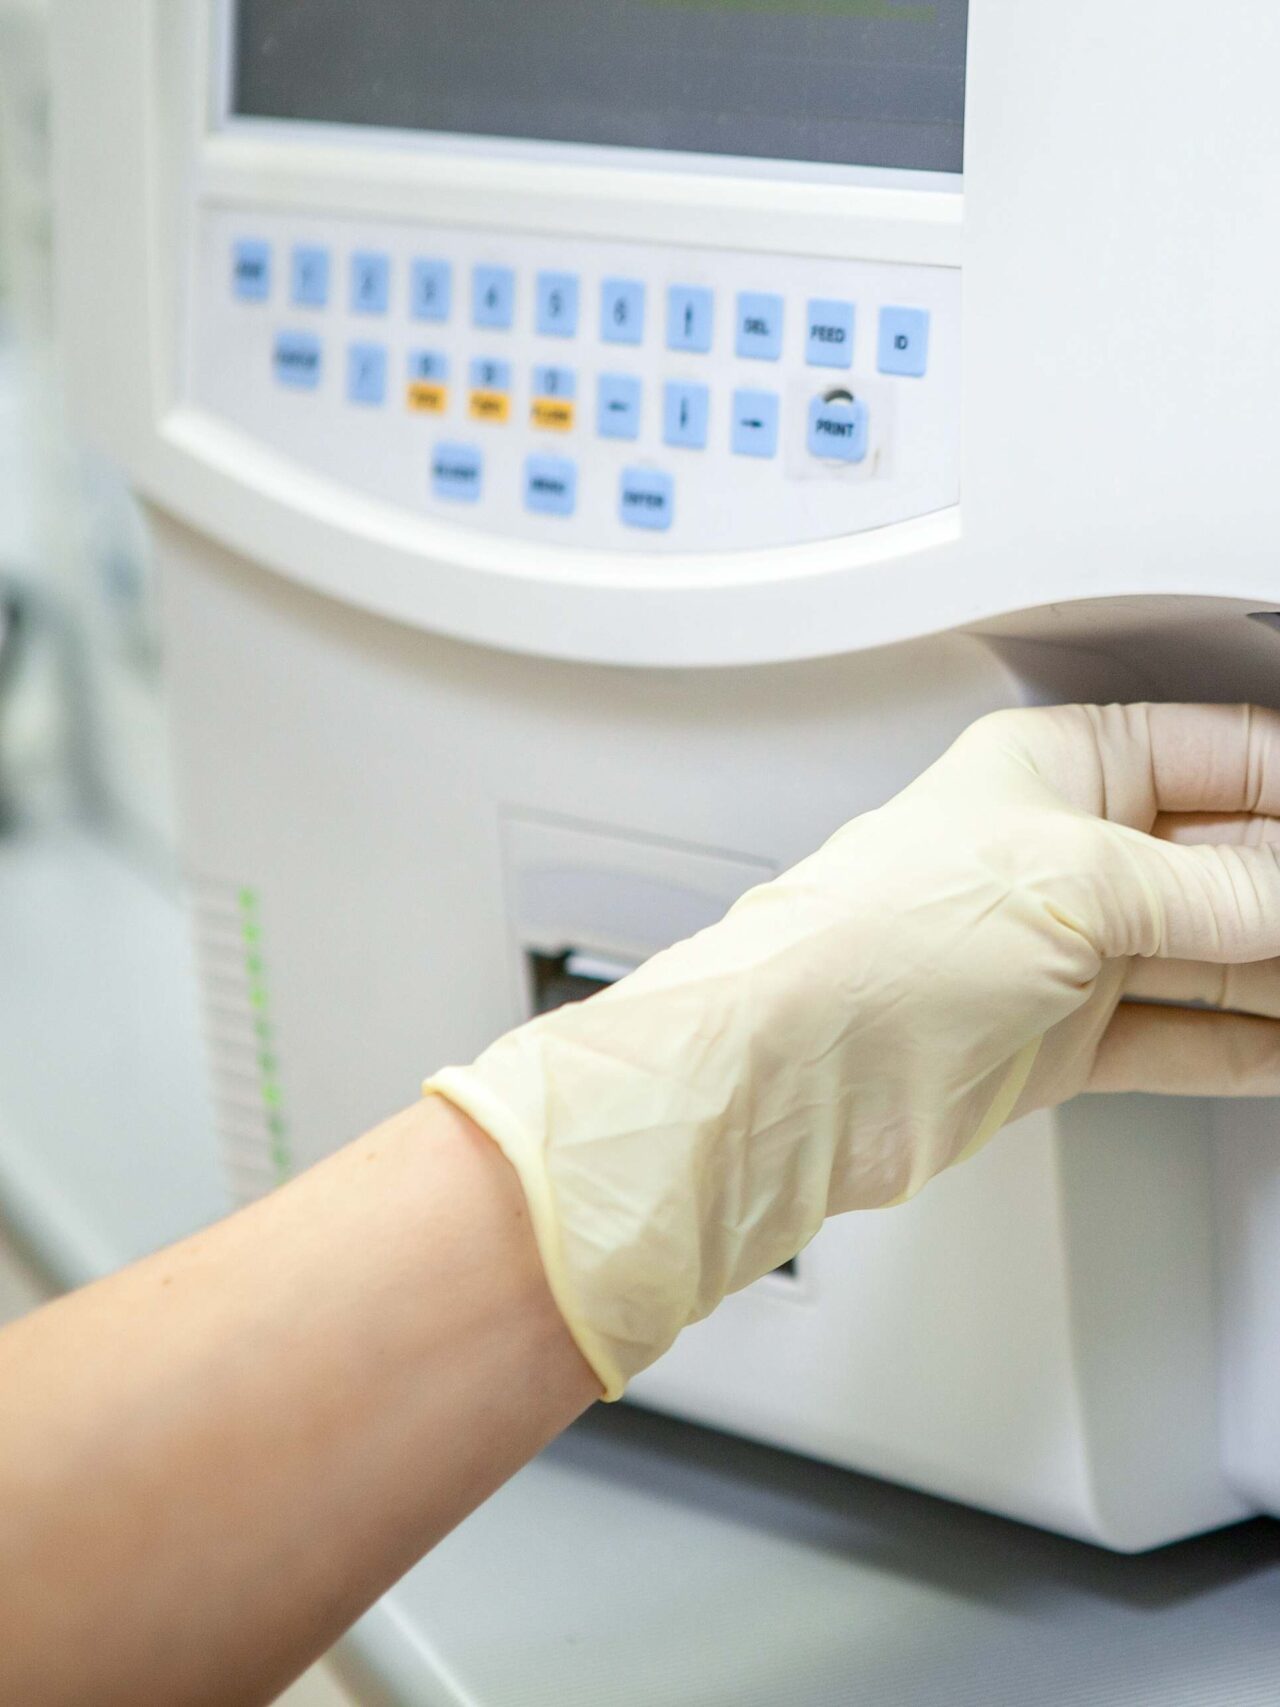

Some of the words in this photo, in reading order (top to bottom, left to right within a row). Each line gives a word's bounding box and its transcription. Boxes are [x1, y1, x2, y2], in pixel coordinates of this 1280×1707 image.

[743, 317, 769, 336] DEL
[811, 324, 846, 343] FEED
[894, 334, 908, 350] ID
[816, 418, 854, 438] PRINT
